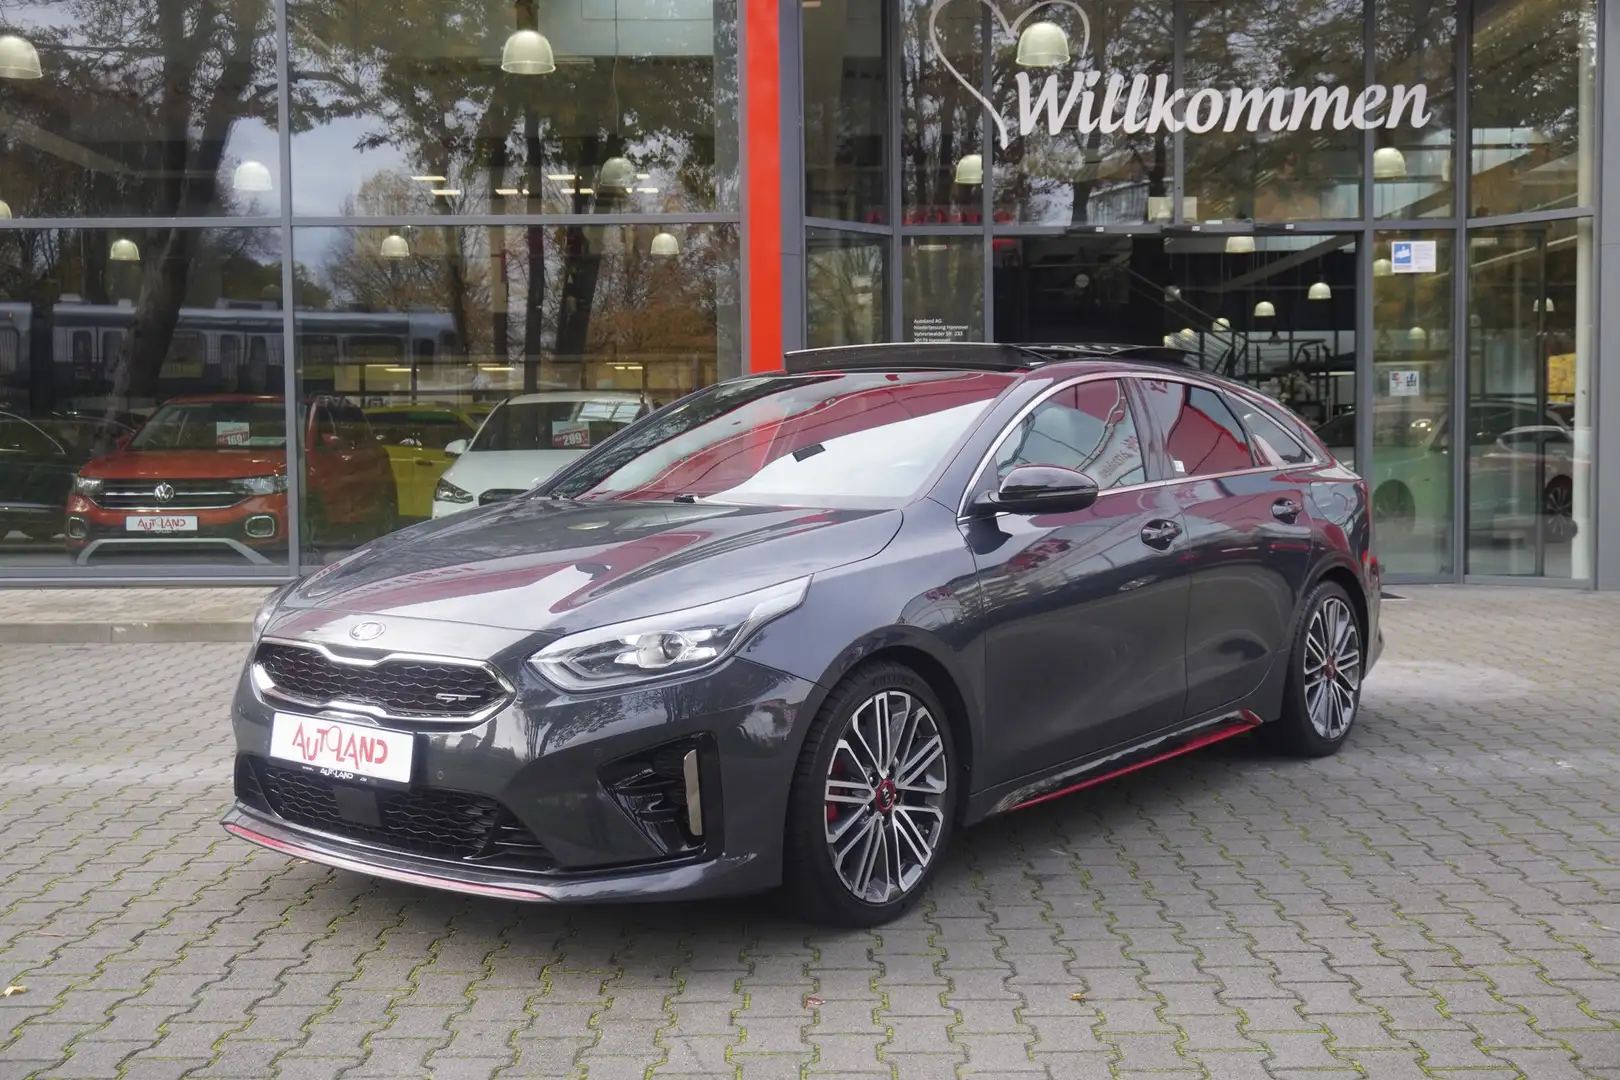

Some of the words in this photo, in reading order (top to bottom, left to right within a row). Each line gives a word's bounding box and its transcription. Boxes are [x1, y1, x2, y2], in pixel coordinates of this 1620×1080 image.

[1015, 70, 1431, 136] Willkommen
[137, 517, 186, 530] AUTOLAND
[436, 693, 482, 703] GT
[292, 721, 388, 770] AUTOLAND
[319, 767, 354, 780] AUTOLAND
[881, 786, 891, 806] KIA
